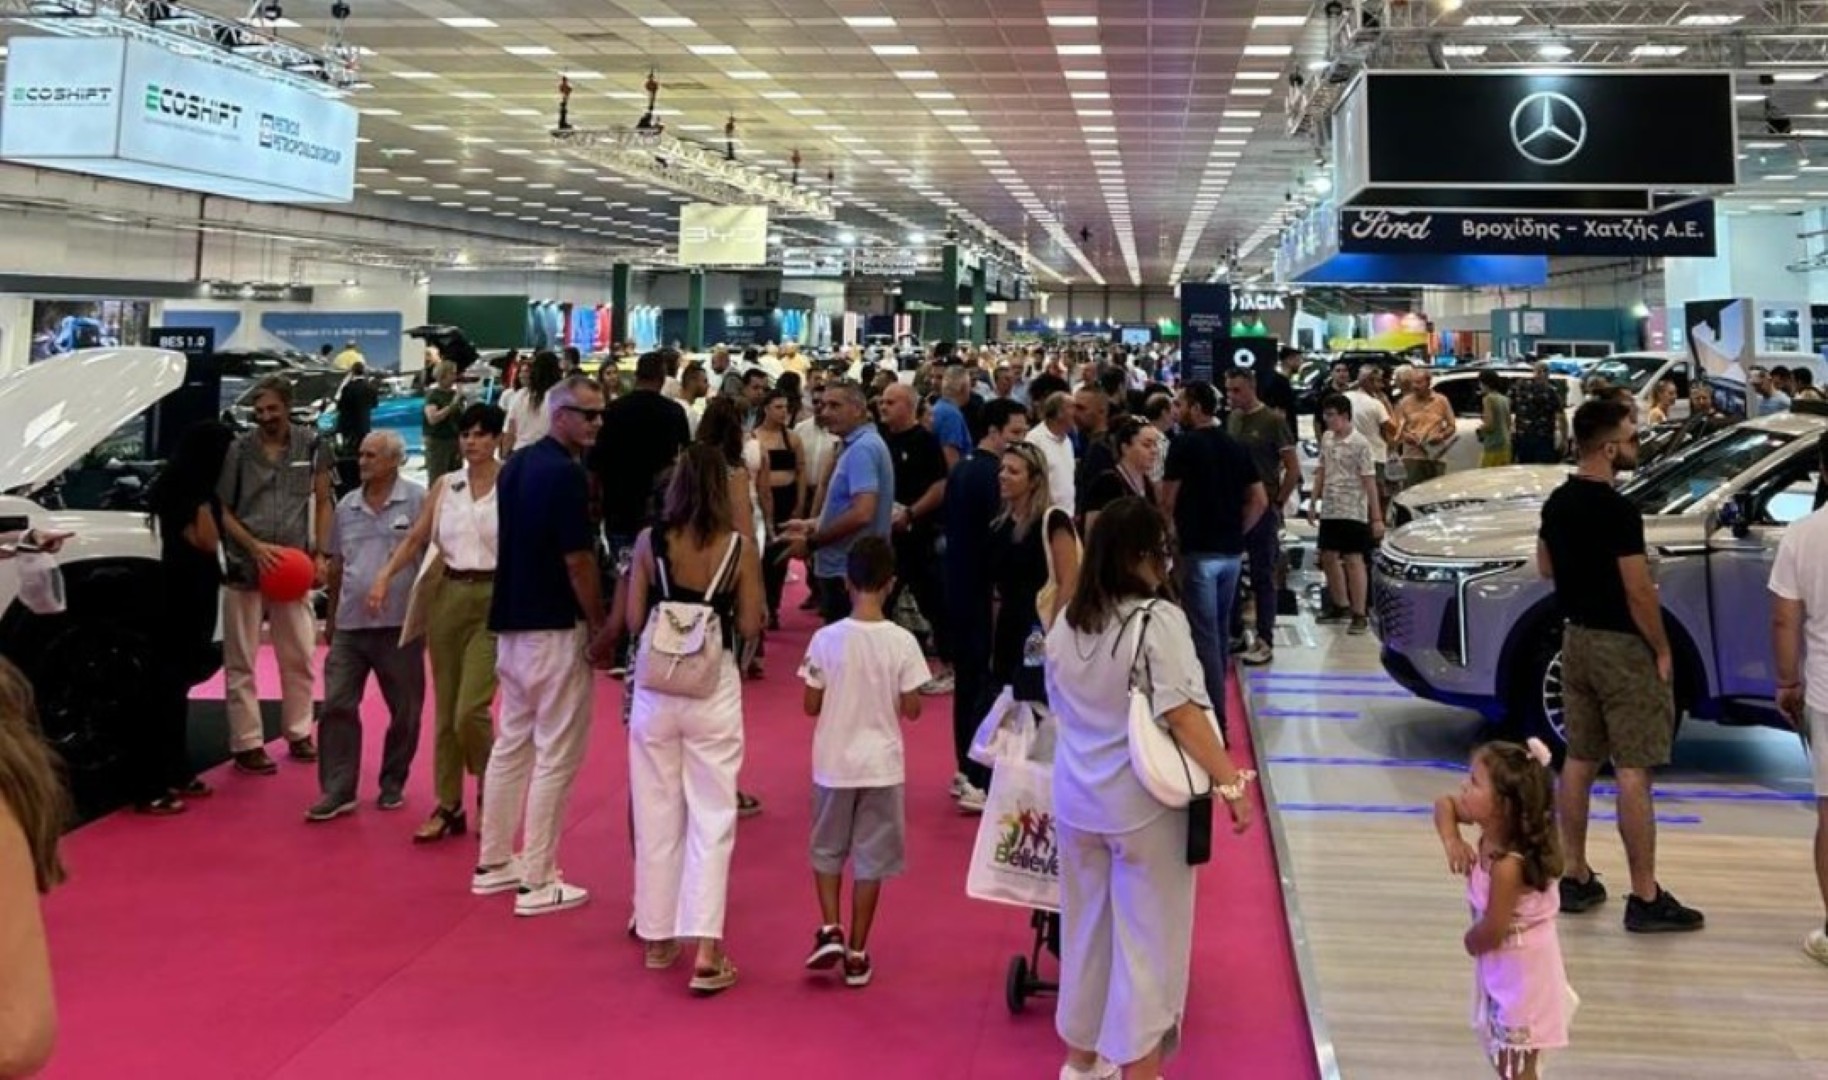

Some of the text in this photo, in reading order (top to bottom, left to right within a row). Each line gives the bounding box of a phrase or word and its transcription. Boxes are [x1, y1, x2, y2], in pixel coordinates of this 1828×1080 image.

[1351, 209, 1431, 241] Ford
[1462, 218, 1560, 241] Βροχίδης
[1583, 218, 1659, 242] Χατζής
